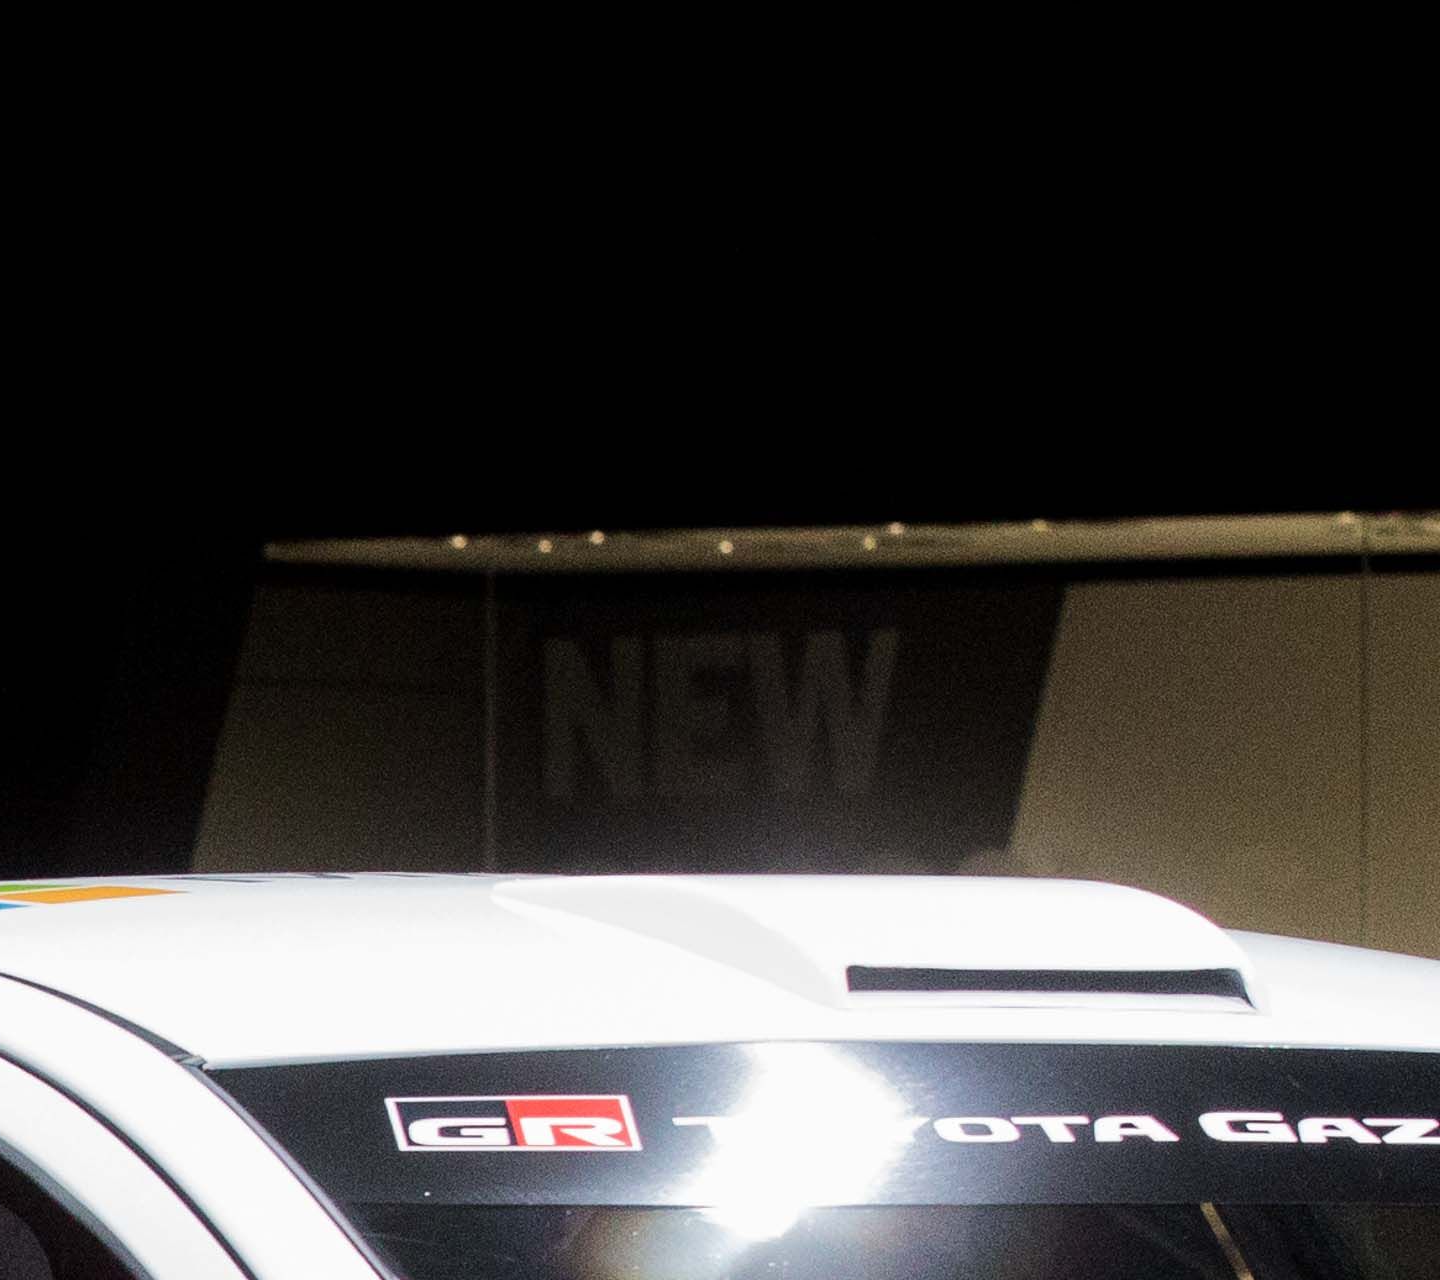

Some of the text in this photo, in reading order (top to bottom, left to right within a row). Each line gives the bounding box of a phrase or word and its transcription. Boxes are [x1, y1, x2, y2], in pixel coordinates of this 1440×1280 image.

[541, 630, 899, 799] NEW
[408, 1116, 628, 1147] GR
[672, 1112, 1440, 1145] TOTA GAZ
